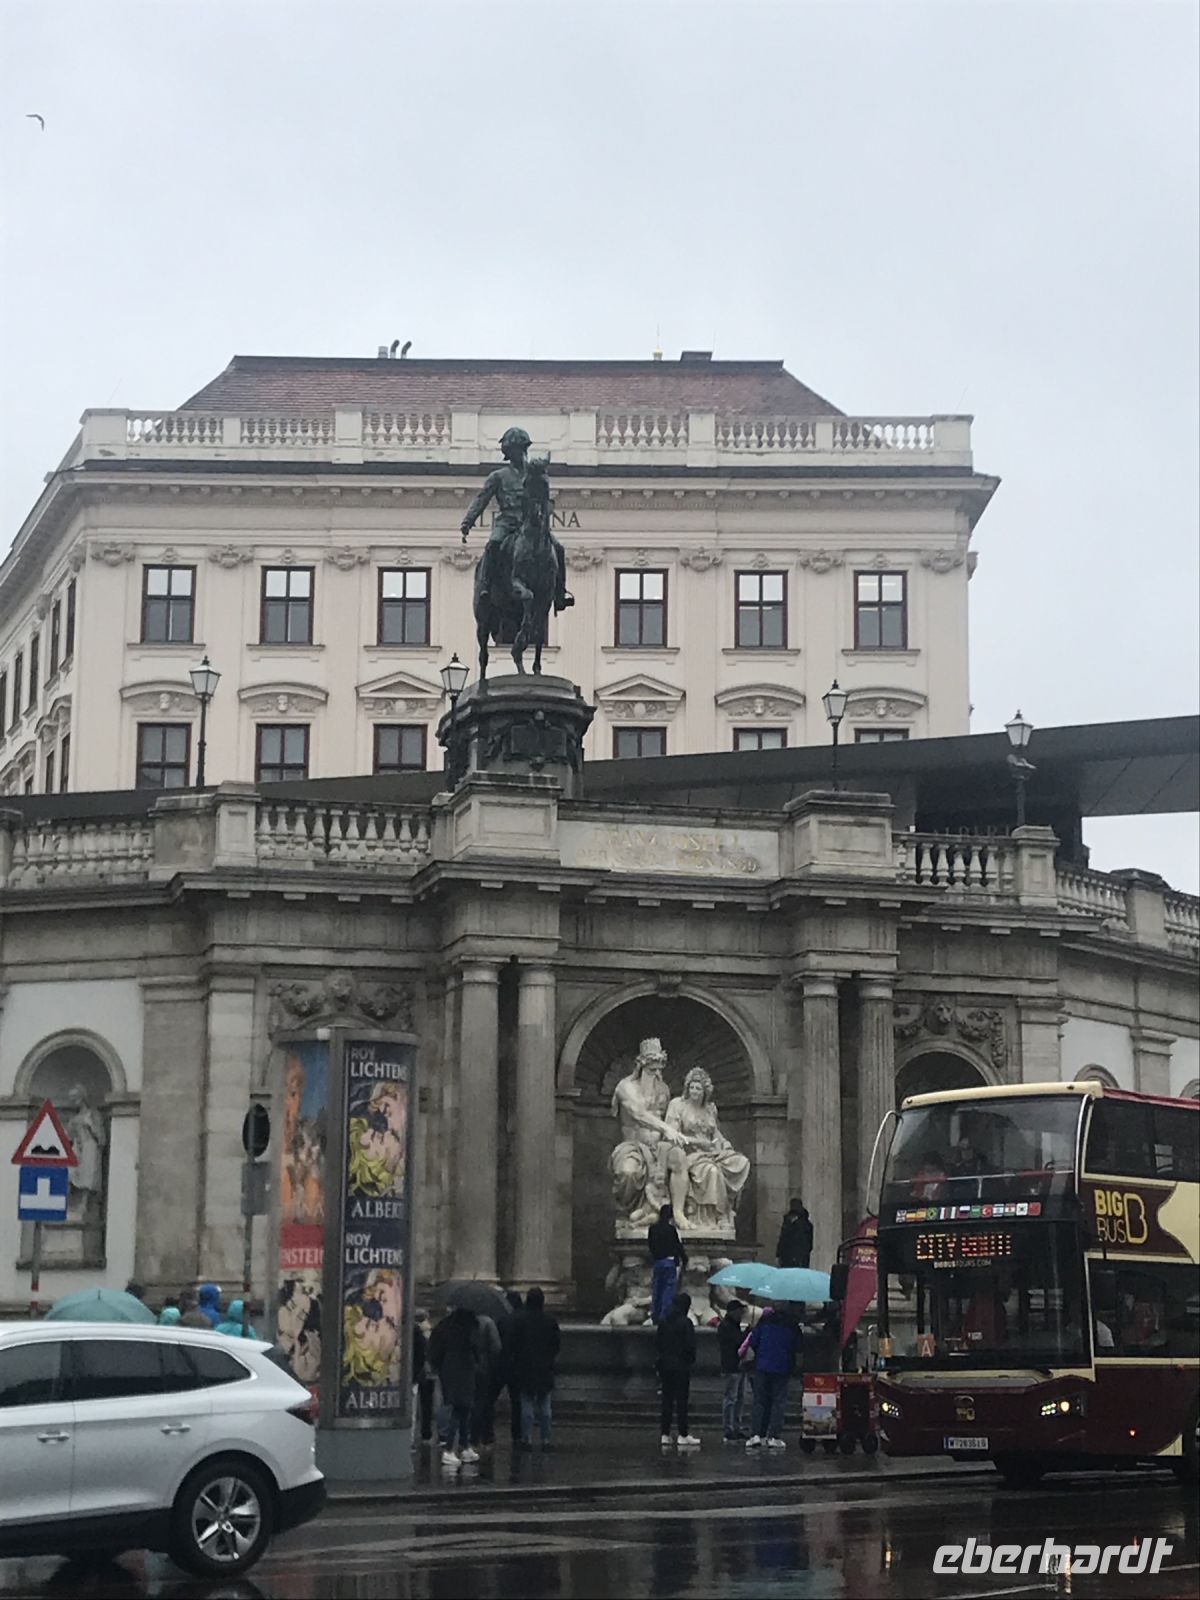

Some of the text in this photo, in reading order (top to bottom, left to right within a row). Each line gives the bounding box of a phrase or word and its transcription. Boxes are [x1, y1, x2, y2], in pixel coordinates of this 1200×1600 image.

[351, 1047, 375, 1060] ROY
[1093, 1188, 1123, 1216] BIG
[346, 1232, 372, 1246] ROY
[1097, 1217, 1126, 1243] BUS
